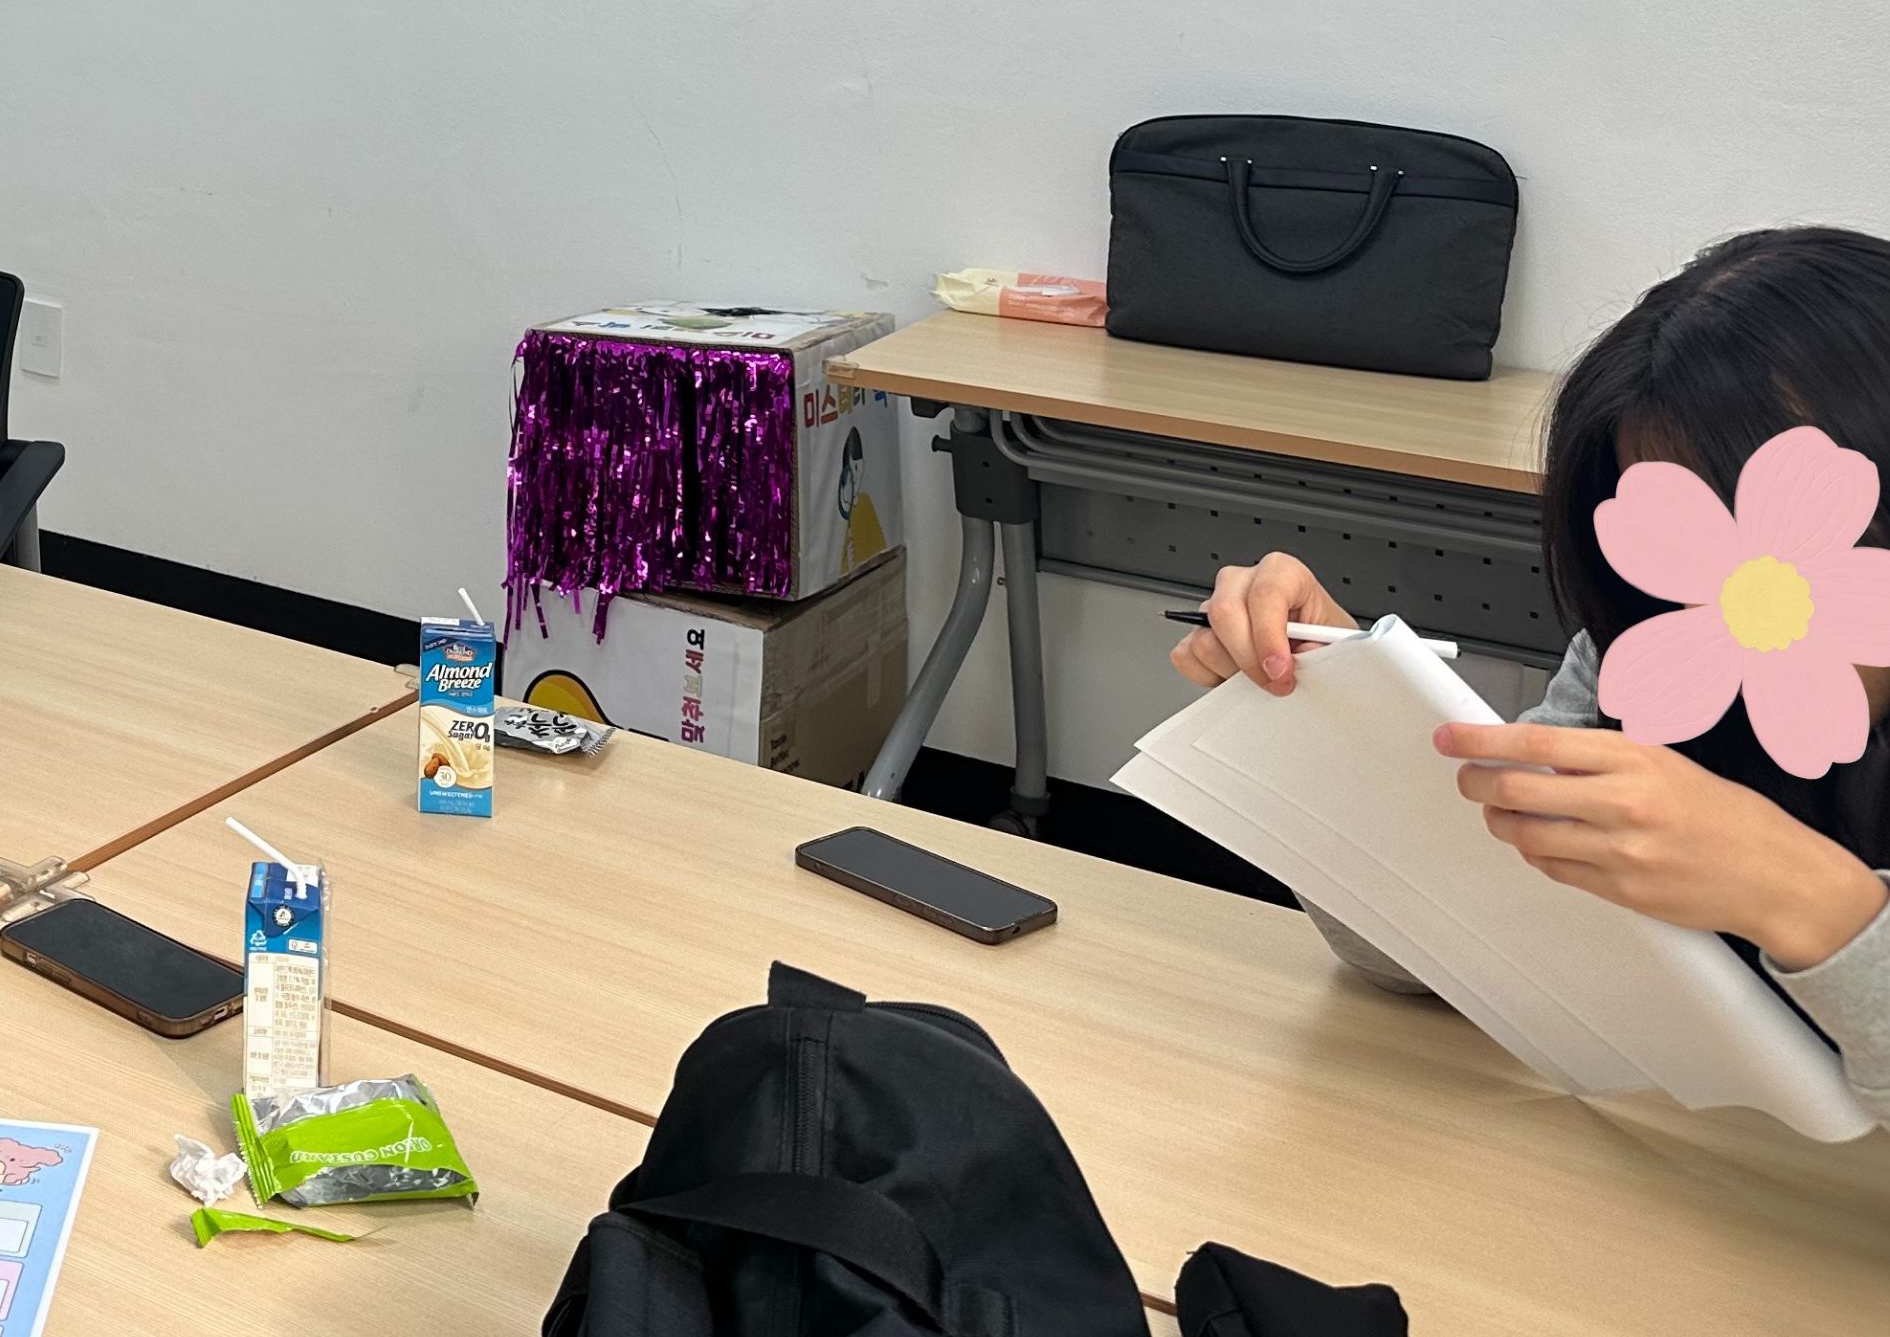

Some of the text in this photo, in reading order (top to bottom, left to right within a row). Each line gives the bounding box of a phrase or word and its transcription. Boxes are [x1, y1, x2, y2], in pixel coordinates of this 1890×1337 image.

[425, 662, 493, 682] Almond
[438, 678, 482, 692] Breeze
[681, 628, 705, 744] 맞춰보세요
[291, 1149, 379, 1164] CUSTARD
